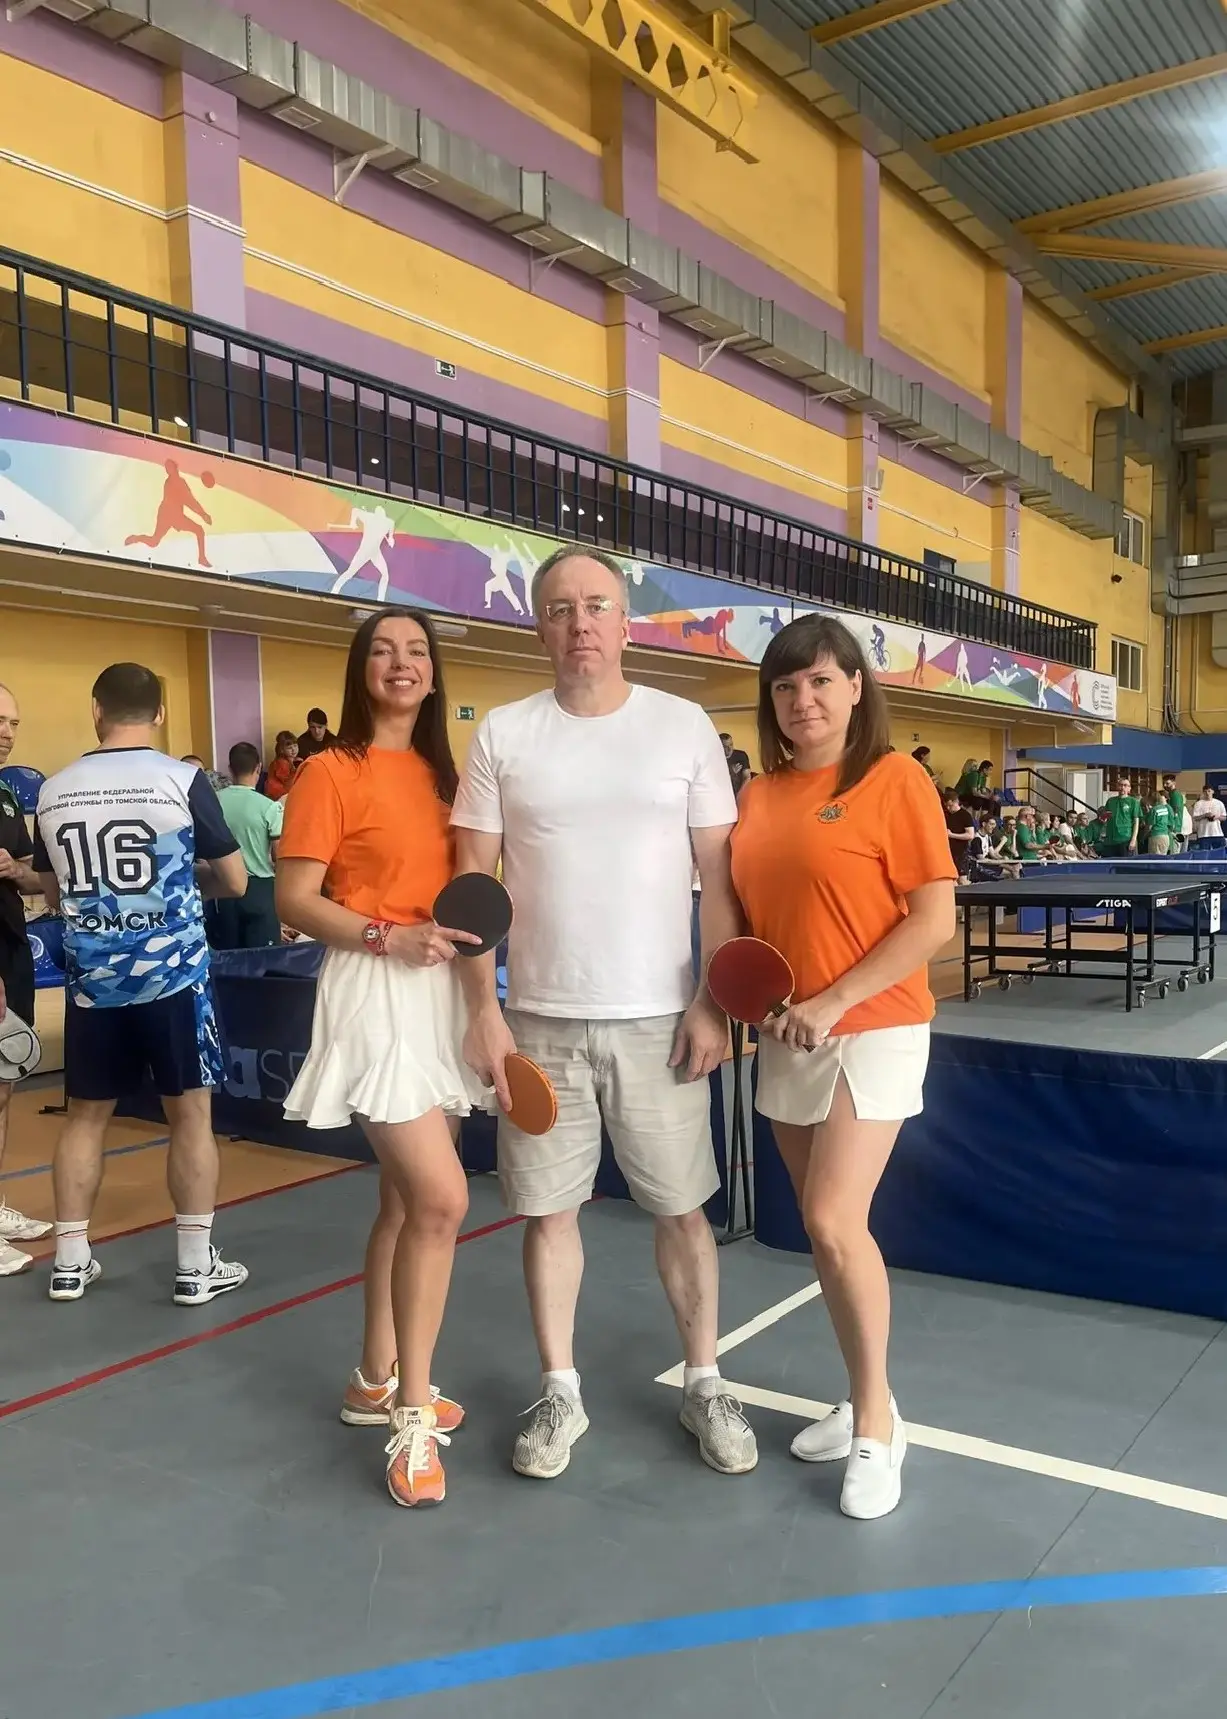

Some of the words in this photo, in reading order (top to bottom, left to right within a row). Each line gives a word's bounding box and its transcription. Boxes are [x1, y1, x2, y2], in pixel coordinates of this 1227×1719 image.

[58, 790, 101, 800] УПРАВЛЕНИЕ
[102, 787, 155, 796] ФЕДЕРАЛЬНОЙ
[70, 800, 102, 808] СЛУЖБЫ
[56, 819, 159, 898] 16
[1096, 899, 1132, 908] STIGA
